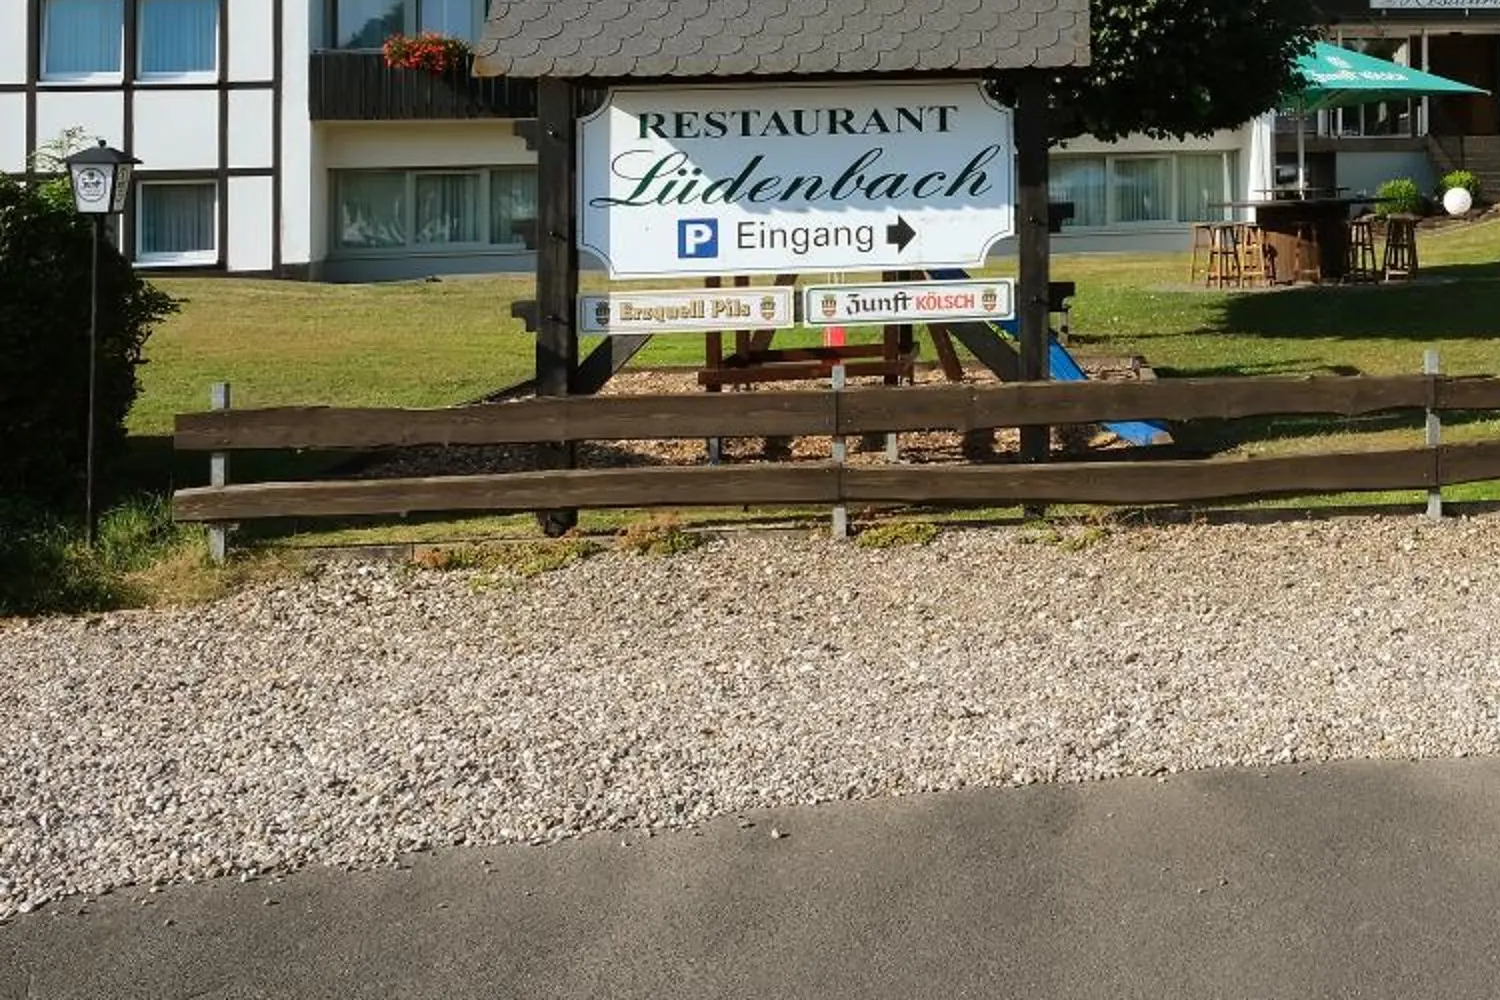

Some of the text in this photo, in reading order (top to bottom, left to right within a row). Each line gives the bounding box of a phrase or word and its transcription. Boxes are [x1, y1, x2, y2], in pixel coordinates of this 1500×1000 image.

[638, 105, 958, 139] RESTAURANT
[589, 143, 1000, 209] Lüdenbach
[685, 220, 874, 255] P Eingang
[711, 299, 751, 318] Pils
[915, 293, 975, 311] KÖLSCH
